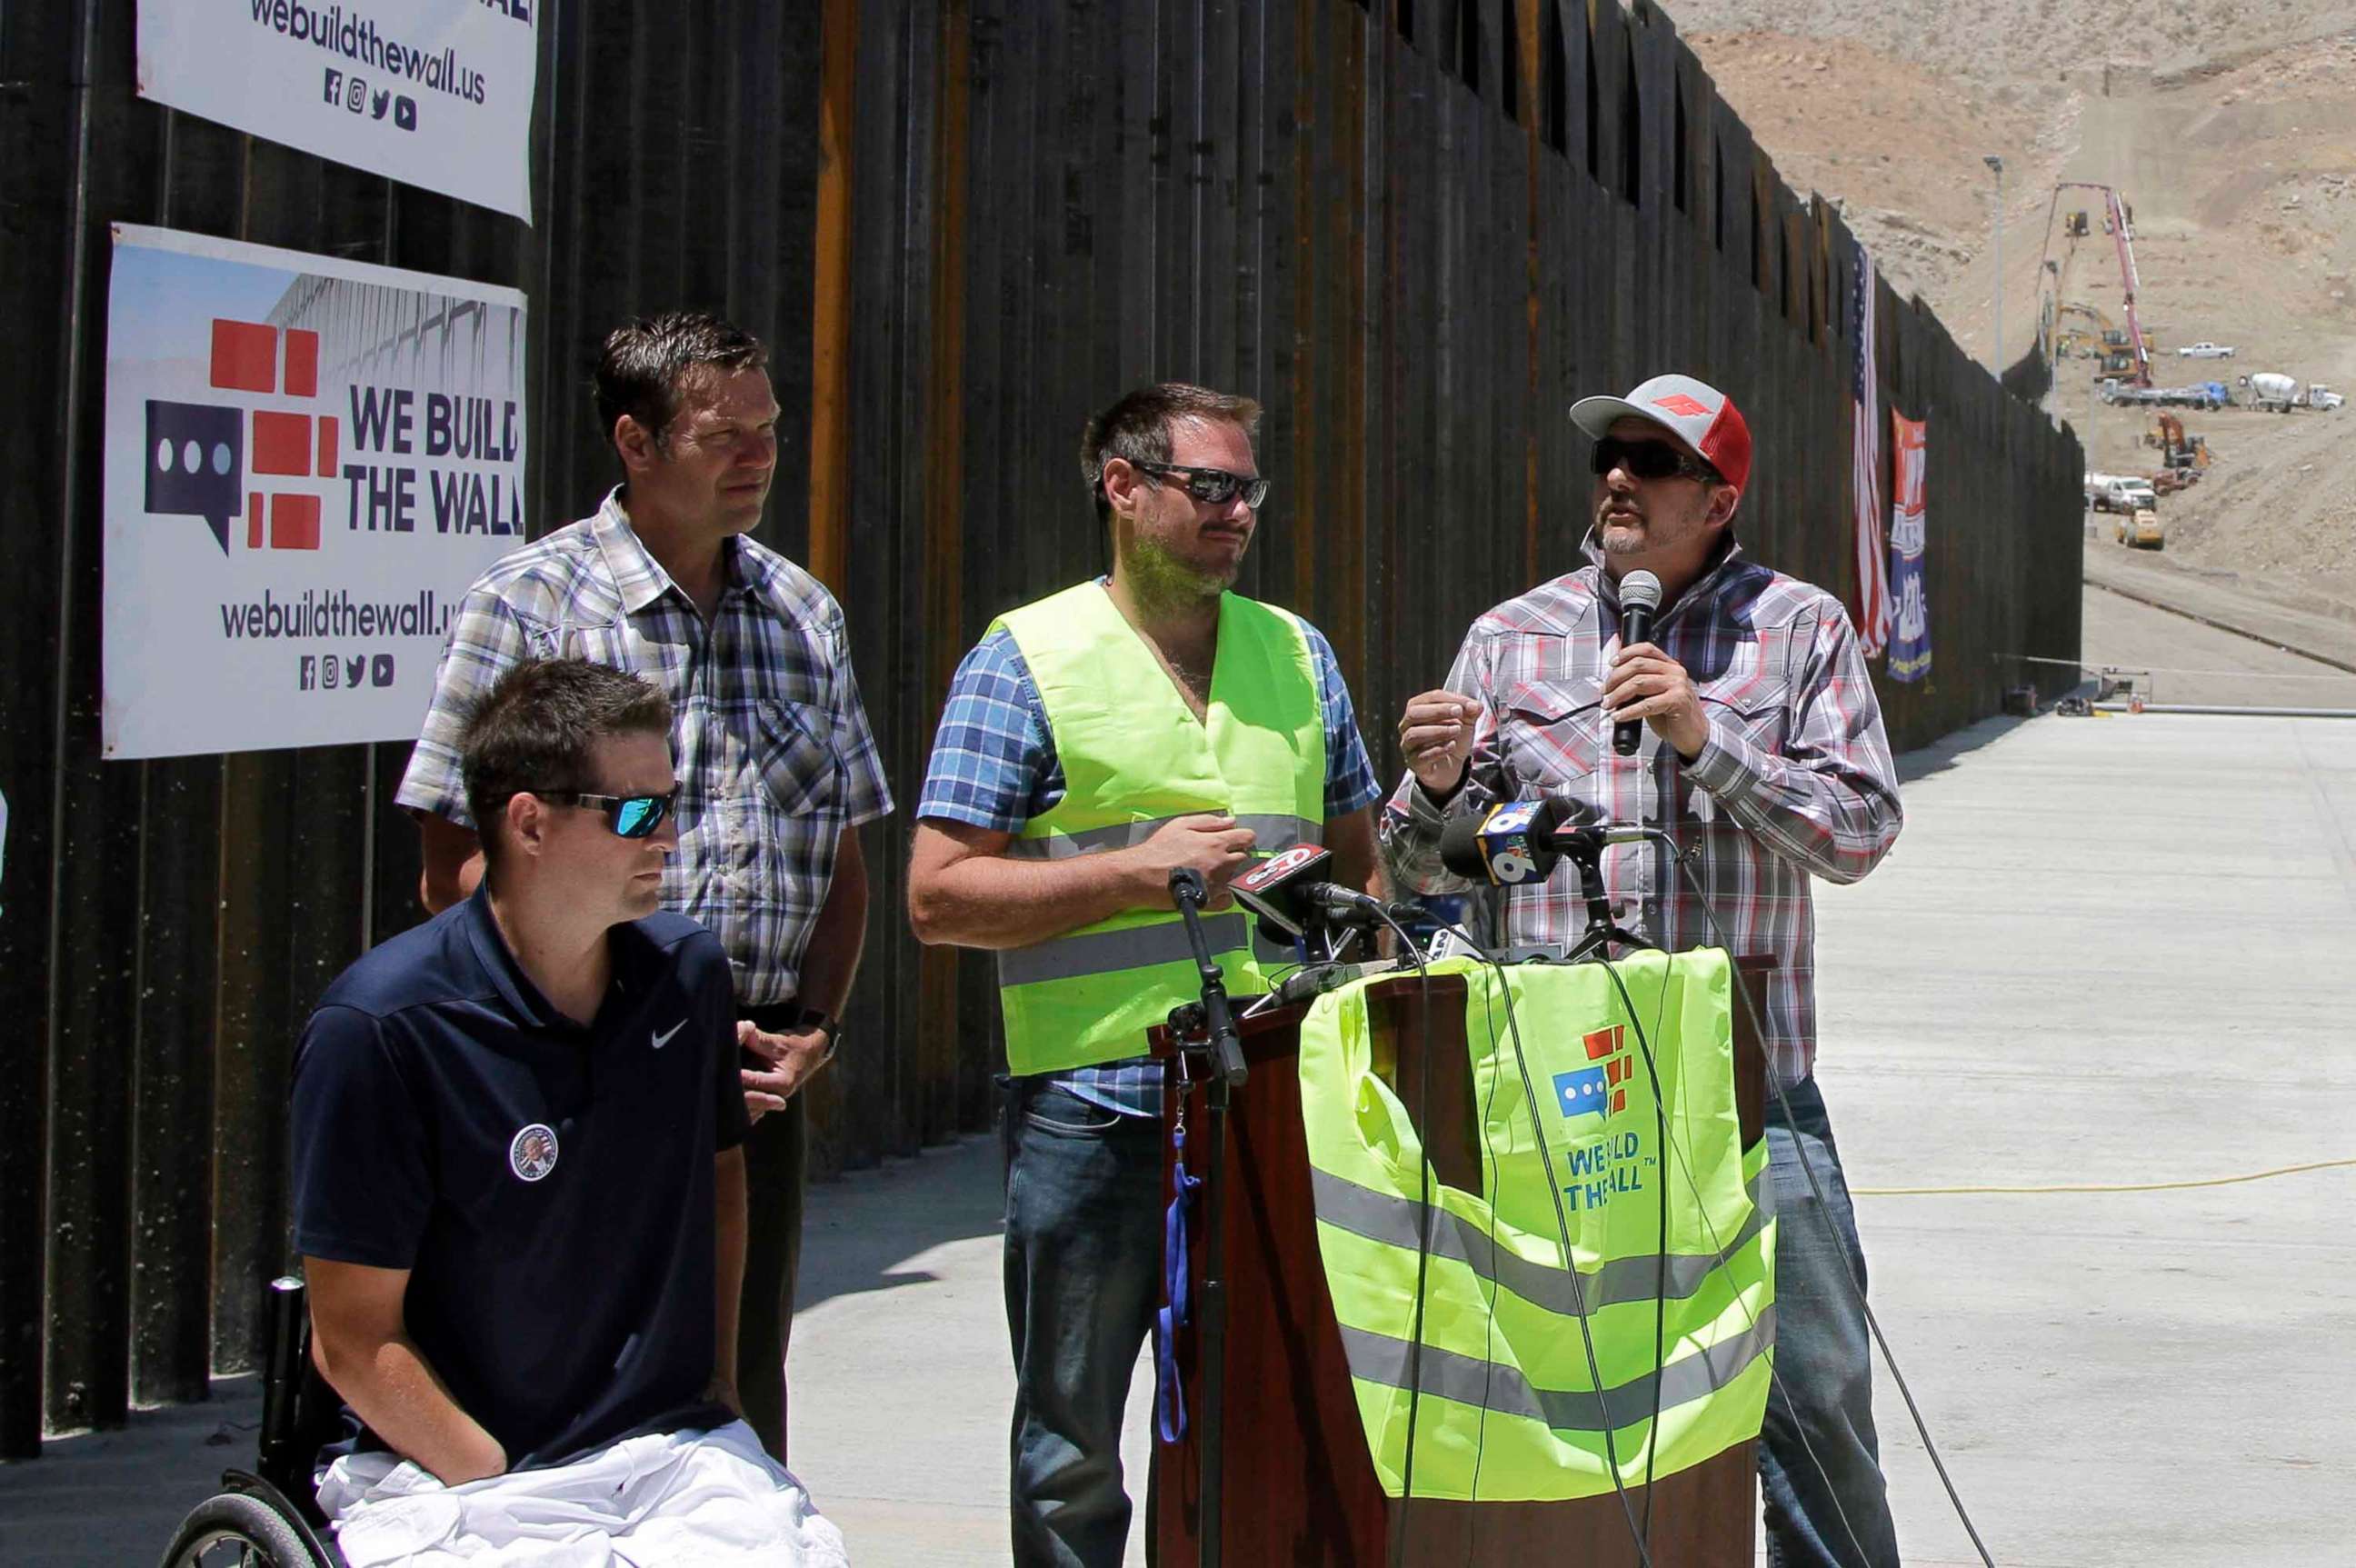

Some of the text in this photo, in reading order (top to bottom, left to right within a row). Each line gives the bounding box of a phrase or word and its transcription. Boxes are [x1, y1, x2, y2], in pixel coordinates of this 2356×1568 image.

[252, 0, 485, 105] webuildthewall.us
[349, 385, 413, 454] WE
[343, 464, 415, 533] THE
[221, 589, 456, 638] webuildthewall.u
[1492, 852, 1537, 883] 9
[1567, 1144, 1605, 1176] WE
[1610, 1165, 1642, 1193] ALL
